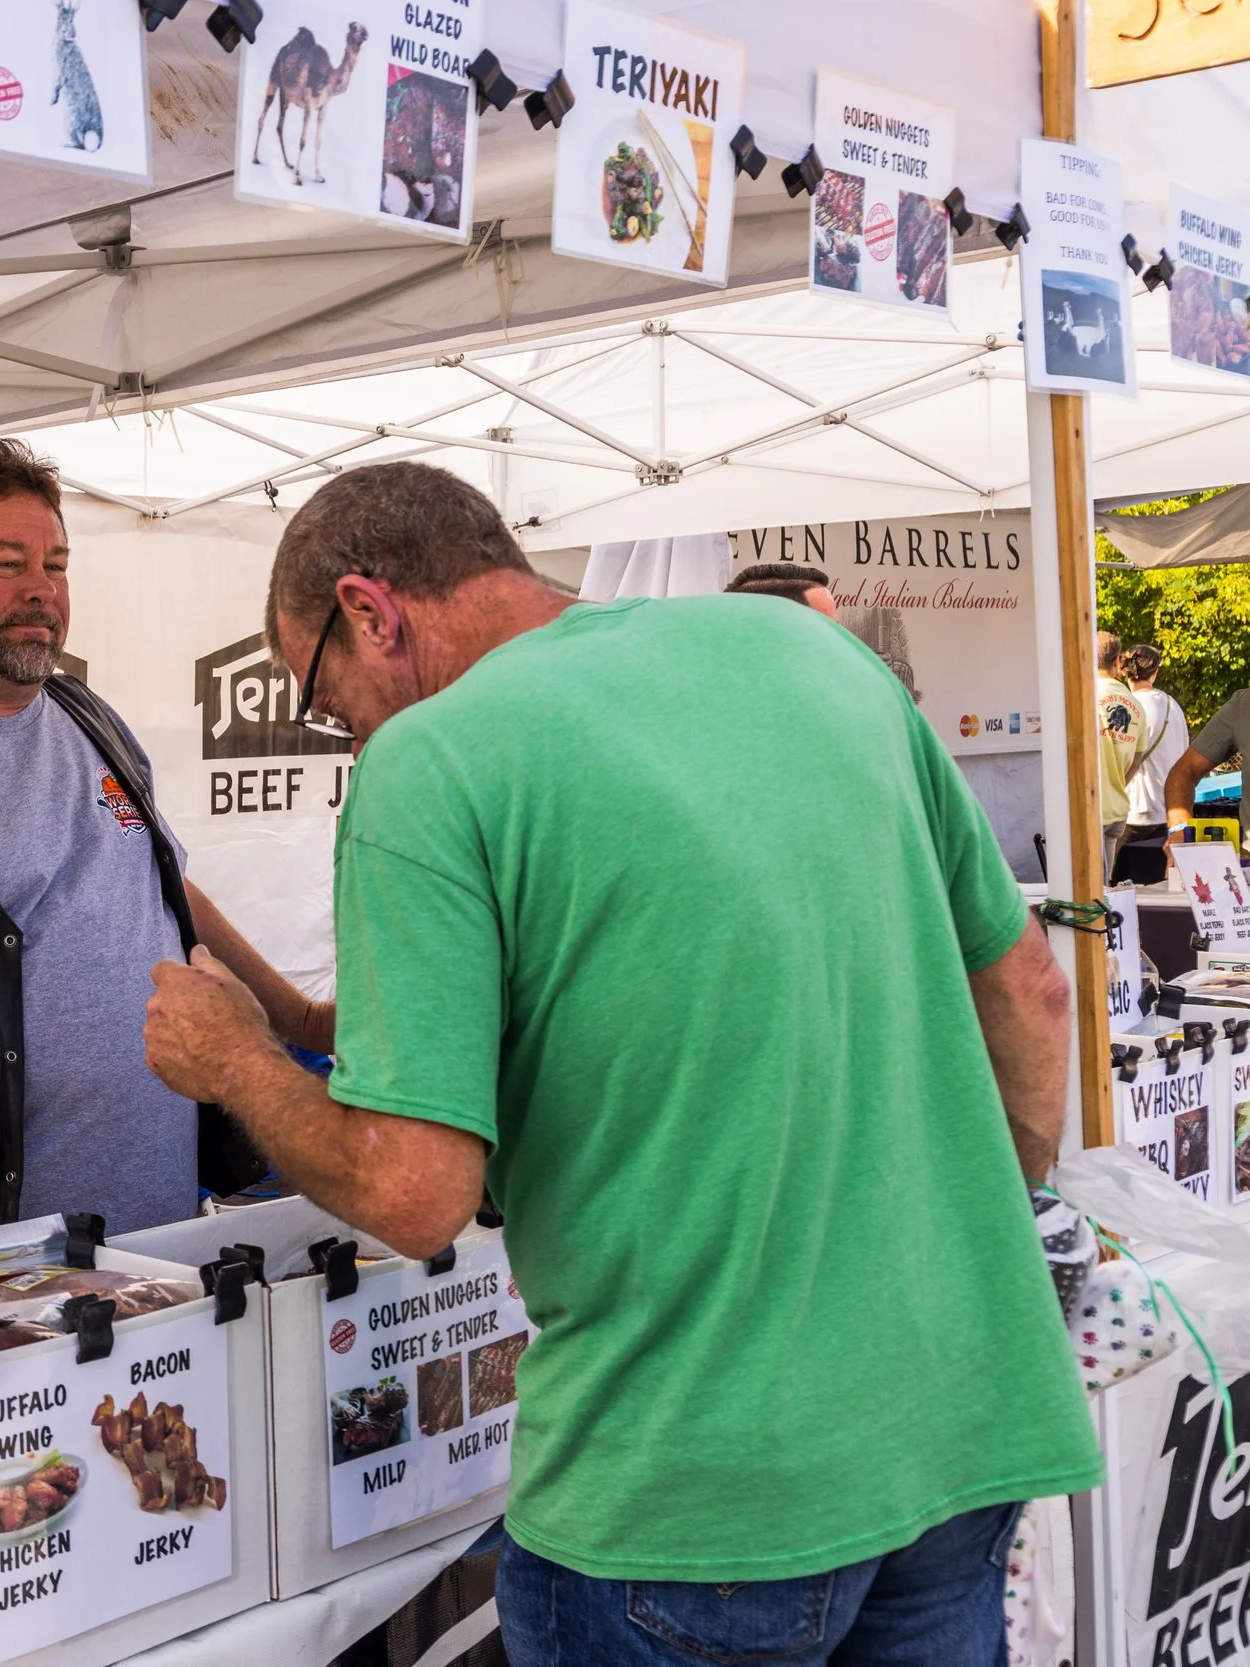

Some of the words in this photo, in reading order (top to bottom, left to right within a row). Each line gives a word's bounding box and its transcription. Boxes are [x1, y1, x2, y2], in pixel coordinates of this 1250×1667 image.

[405, 3, 462, 40] GLAZED
[391, 34, 428, 66] WILD
[592, 45, 719, 121] TERIYAKI
[844, 105, 882, 134] GOLDEN
[885, 117, 930, 148] NUGGETS
[842, 138, 879, 166] SWEET
[881, 150, 889, 168] &
[892, 153, 928, 180] TENDER
[1046, 190, 1067, 205] BAD
[1070, 194, 1087, 208] FOR
[1050, 209, 1079, 224] GOOD
[1081, 213, 1096, 228] FOR
[1181, 210, 1216, 240] BUFFALO
[1219, 224, 1242, 249] WING
[1060, 245, 1093, 261] THANK
[1094, 252, 1109, 266] YOU
[1179, 240, 1214, 271] CHICKEN
[1216, 255, 1243, 280] JERKY
[853, 520, 1021, 571] BARRELS
[864, 578, 928, 609] Italian
[933, 578, 1019, 610] Balsamics
[985, 718, 1003, 732] VISA
[211, 767, 303, 815] BEEF
[1108, 979, 1131, 1018] LIC
[1131, 1071, 1204, 1123] WHISKEY
[369, 1292, 431, 1331] GOLDEN
[434, 1272, 498, 1313] NUGGETS
[370, 1332, 427, 1371] SWEET
[431, 1329, 443, 1352] &
[446, 1309, 499, 1348] TENDER
[130, 1348, 191, 1385] BACON
[448, 1432, 481, 1465] MED.
[484, 1418, 510, 1447] HOT
[362, 1458, 407, 1495] MILD
[1168, 1375, 1250, 1570] Je
[134, 1525, 194, 1566] JERKY
